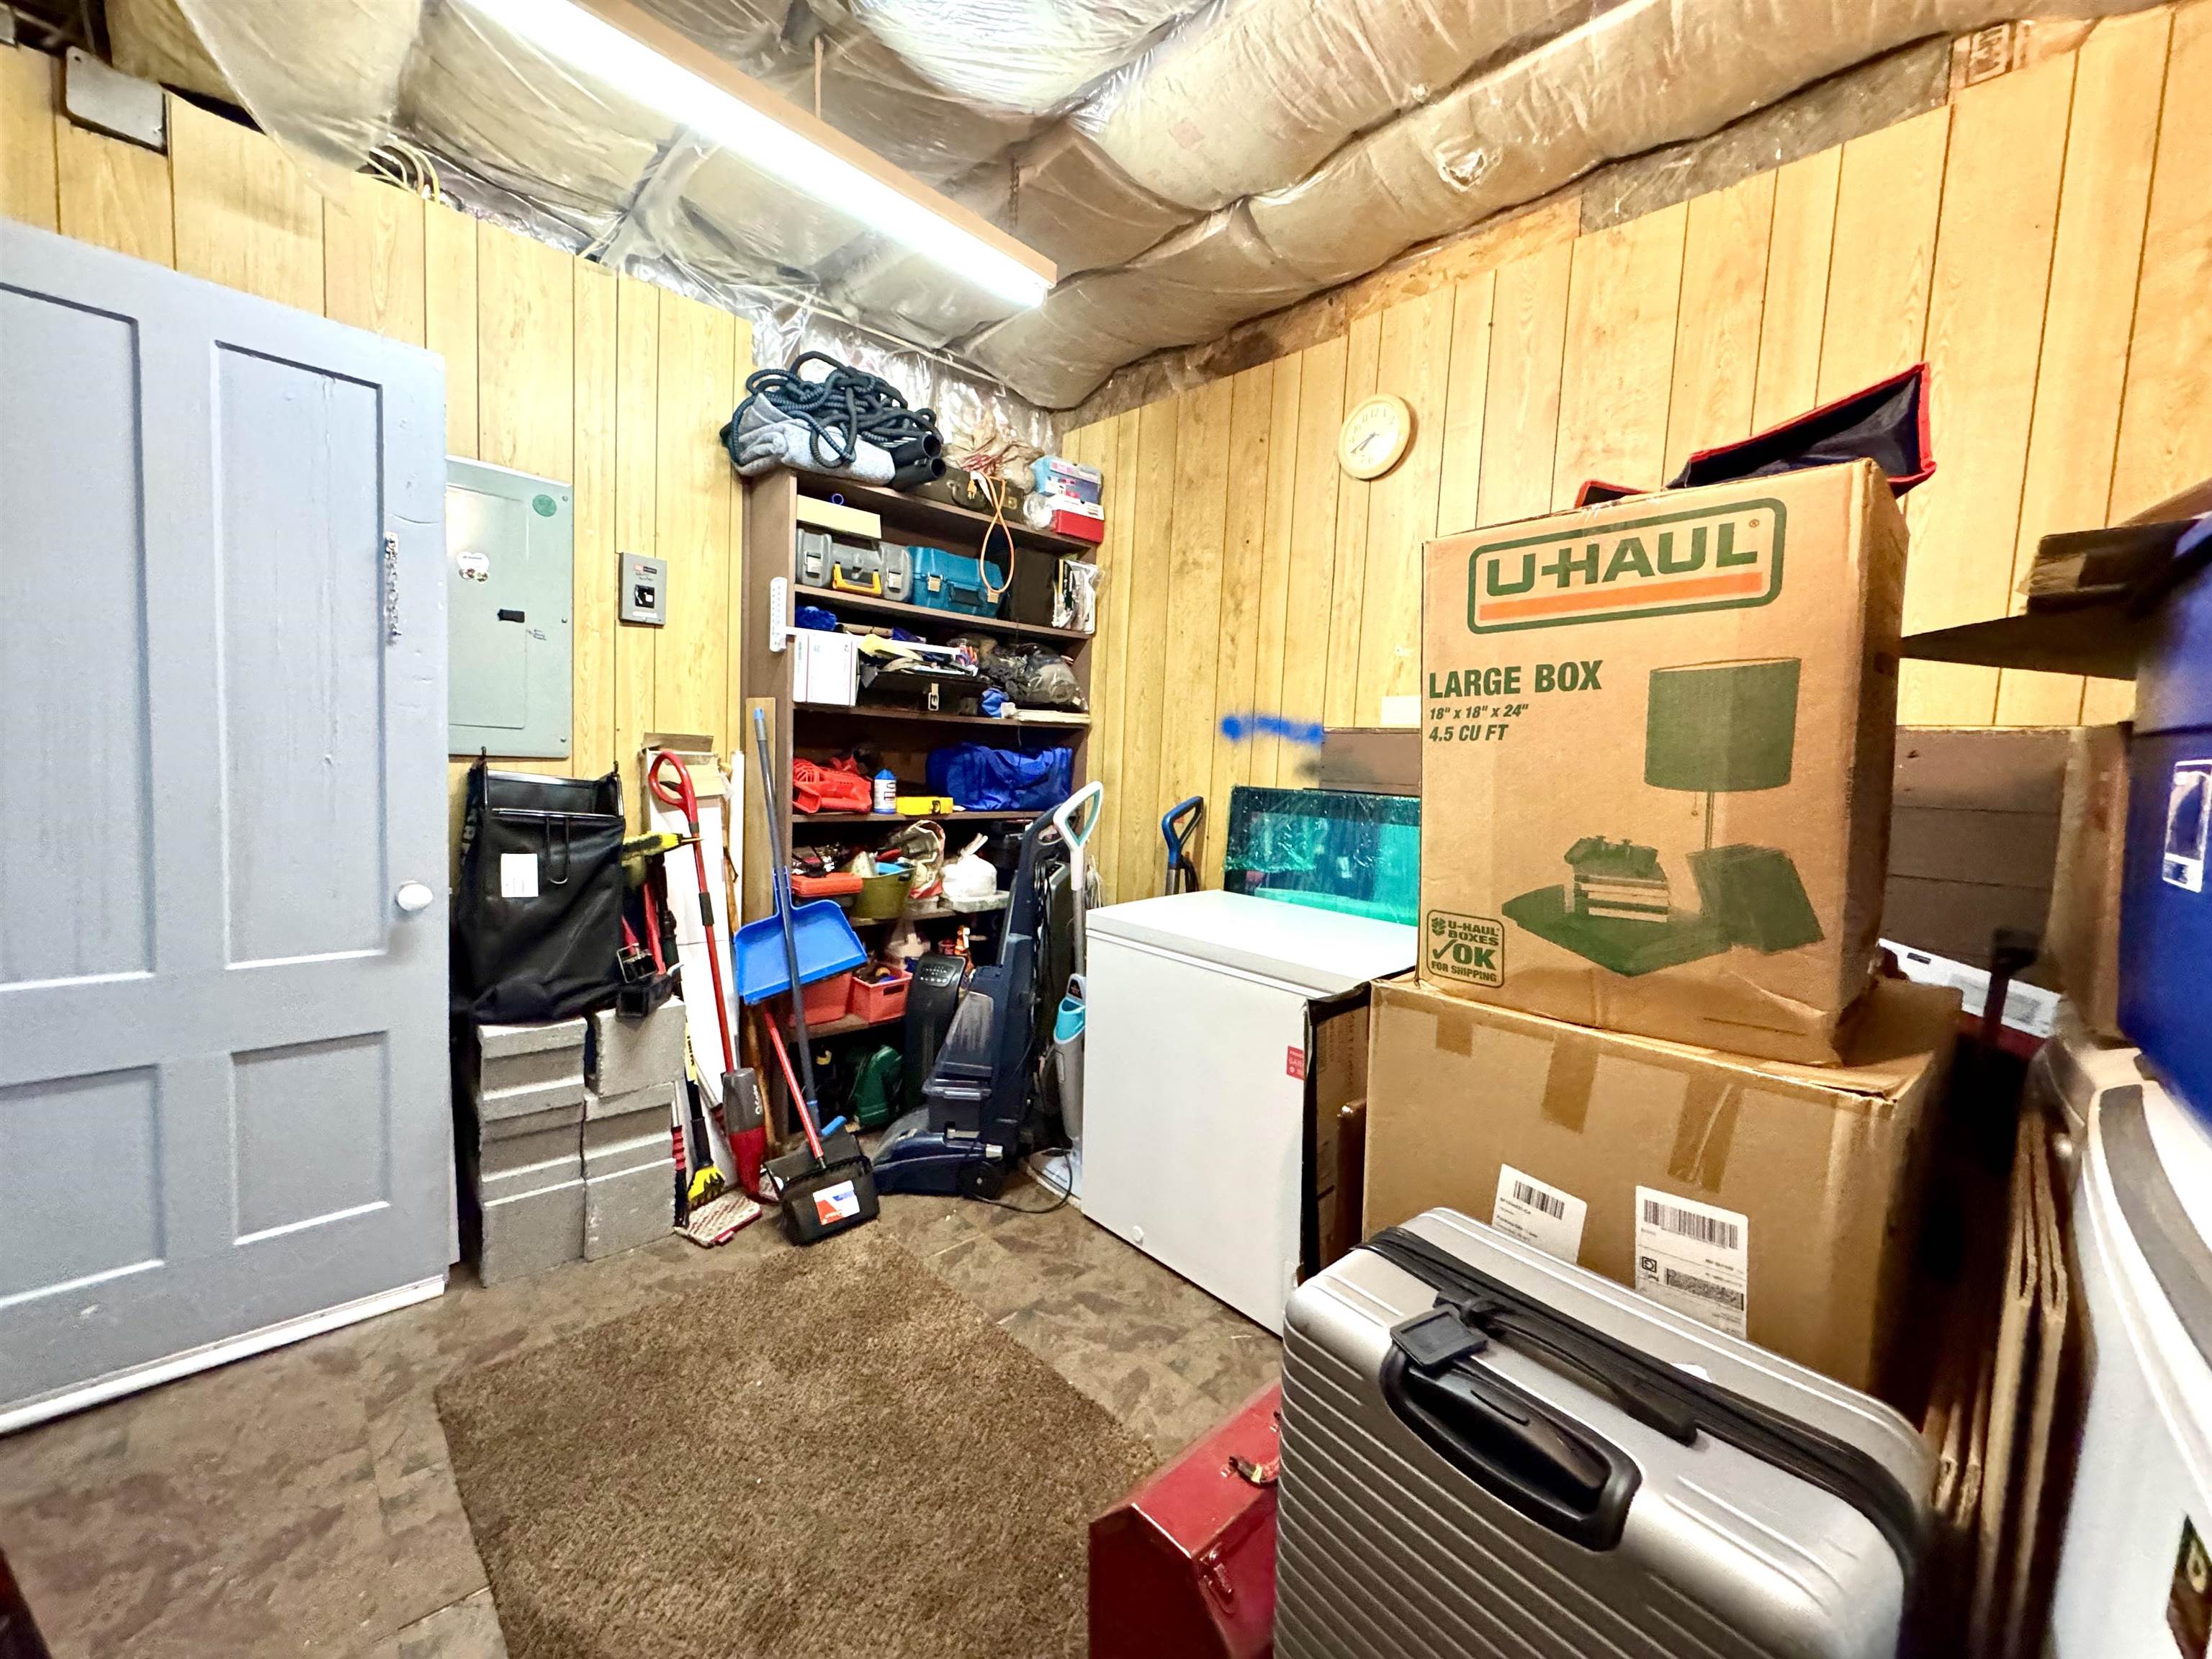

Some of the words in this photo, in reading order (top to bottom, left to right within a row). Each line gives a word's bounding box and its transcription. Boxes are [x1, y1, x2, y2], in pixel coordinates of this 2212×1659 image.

[1487, 522, 1758, 597] U-HAUL
[1429, 666, 1521, 698] LARGE
[1534, 660, 1604, 693] BOX
[1430, 706, 1451, 720] 18"
[1453, 709, 1462, 719] x
[1465, 705, 1488, 719] 18"
[1491, 707, 1501, 718] x
[1503, 703, 1529, 718] 24"
[1429, 726, 1454, 742] 4.5
[1459, 724, 1482, 741] CU
[1485, 724, 1509, 741] FT
[1448, 920, 1499, 937] U-HAUL
[1448, 930, 1499, 946] BOXES
[1452, 943, 1497, 971] OK
[1431, 961, 1449, 972] FOR
[1451, 965, 1497, 982] SHIPPING
